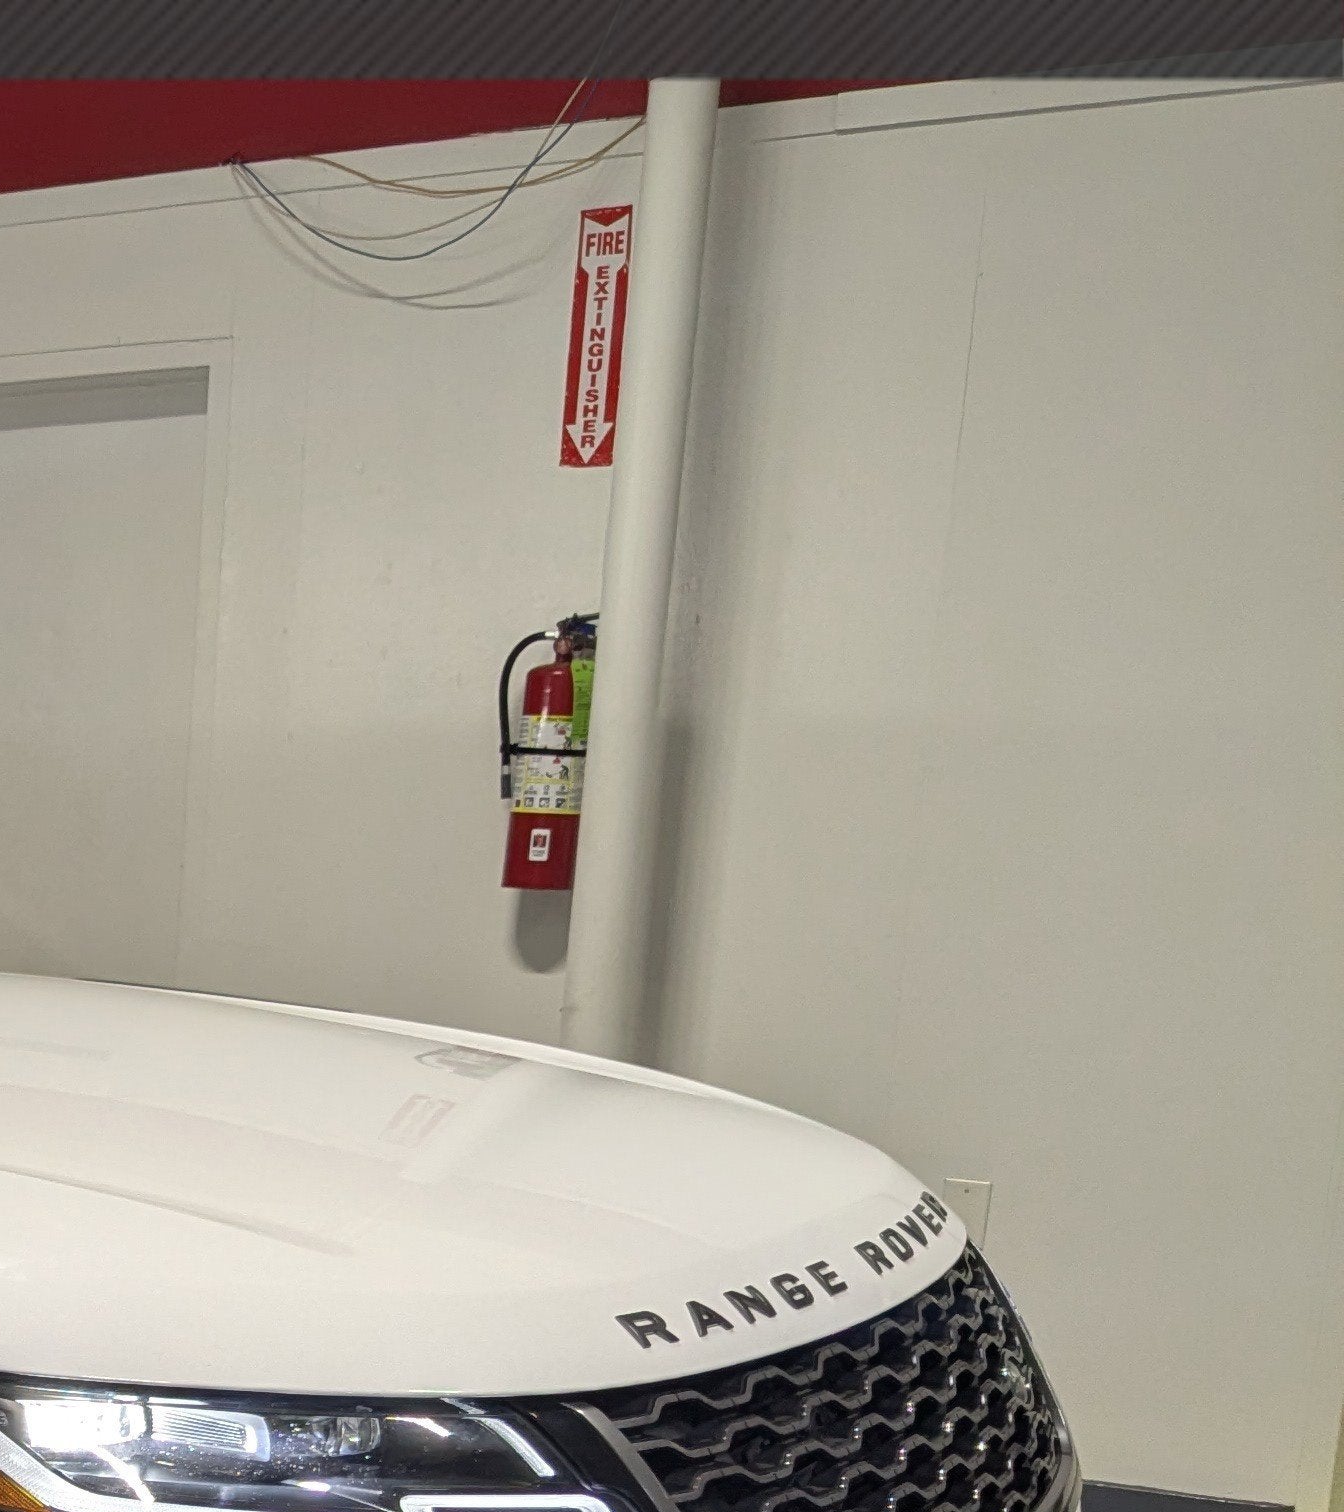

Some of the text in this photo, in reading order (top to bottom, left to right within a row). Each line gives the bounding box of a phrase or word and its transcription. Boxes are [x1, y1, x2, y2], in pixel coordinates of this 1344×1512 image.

[585, 230, 626, 257] FIRE
[580, 265, 611, 449] EXTINGUISHER
[615, 1190, 948, 1349] RANGE ROVER
